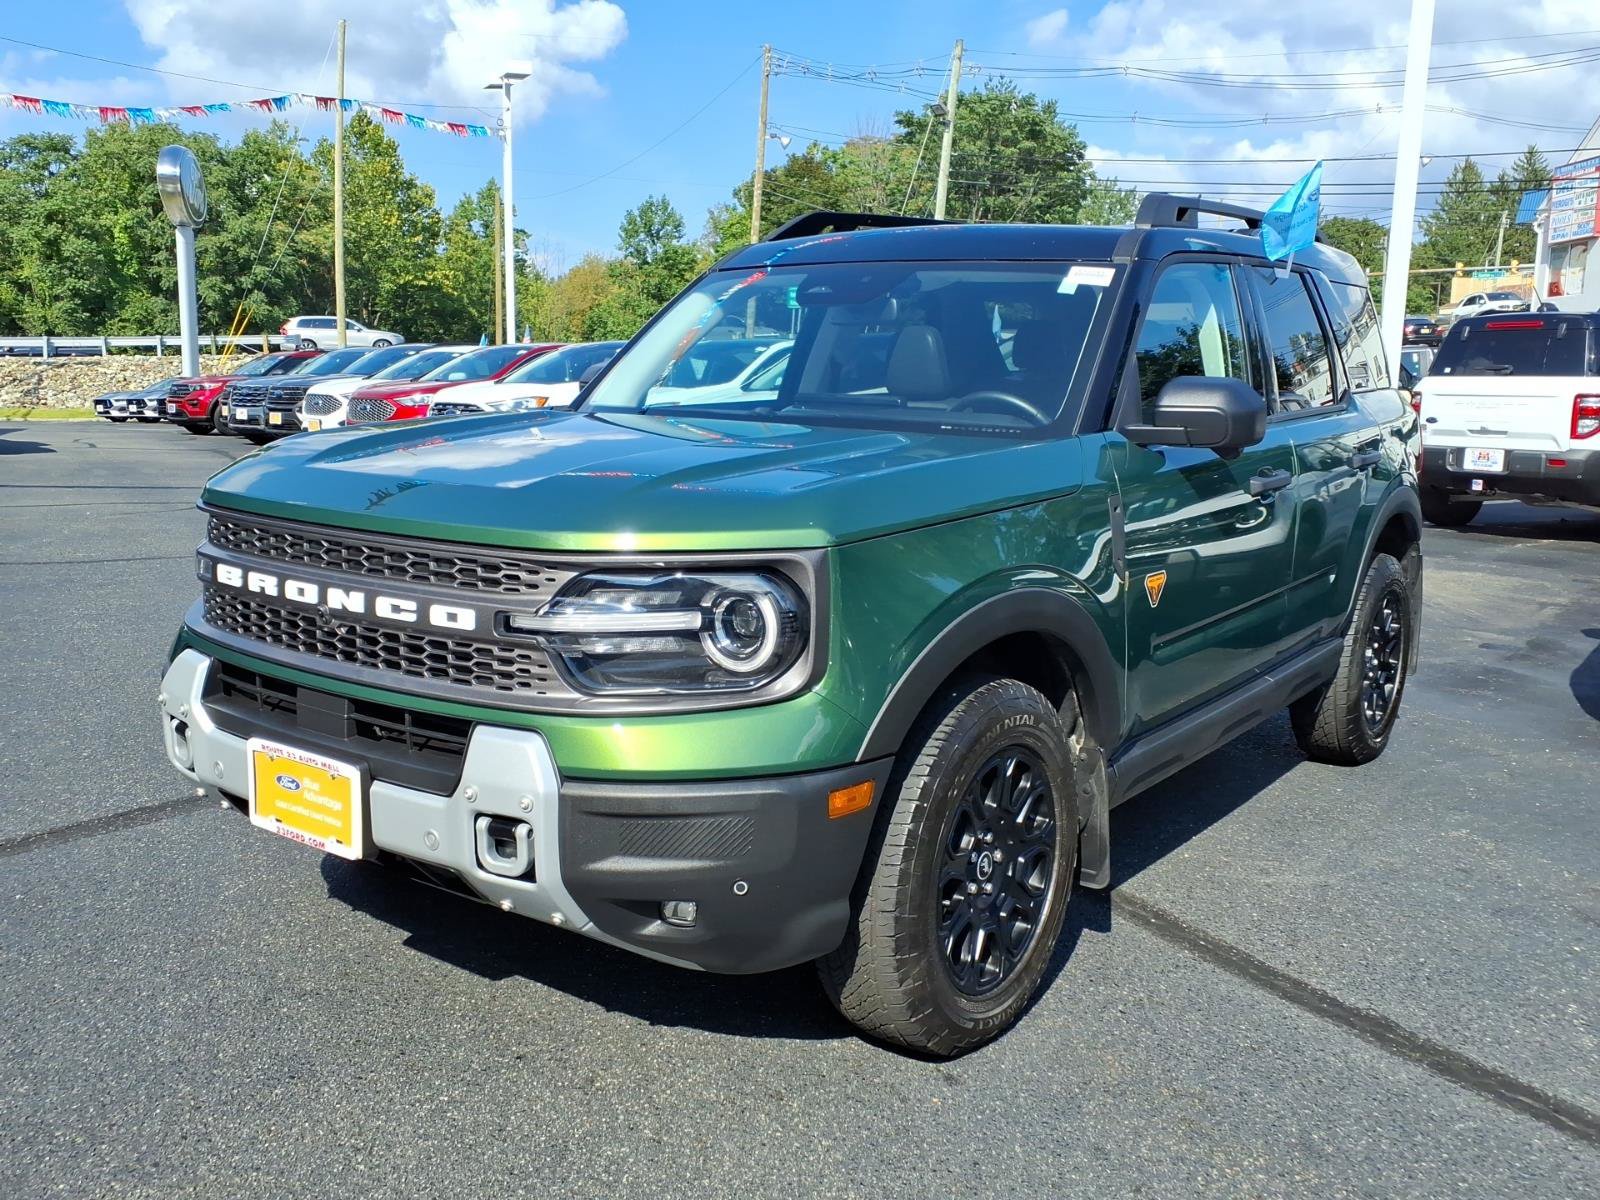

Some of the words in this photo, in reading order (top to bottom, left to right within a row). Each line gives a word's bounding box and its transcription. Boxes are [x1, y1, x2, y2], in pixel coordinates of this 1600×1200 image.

[216, 563, 476, 631] BRONCO
[261, 744, 283, 755] ROUTE
[298, 755, 319, 766] AUTO
[279, 776, 297, 790] Ford
